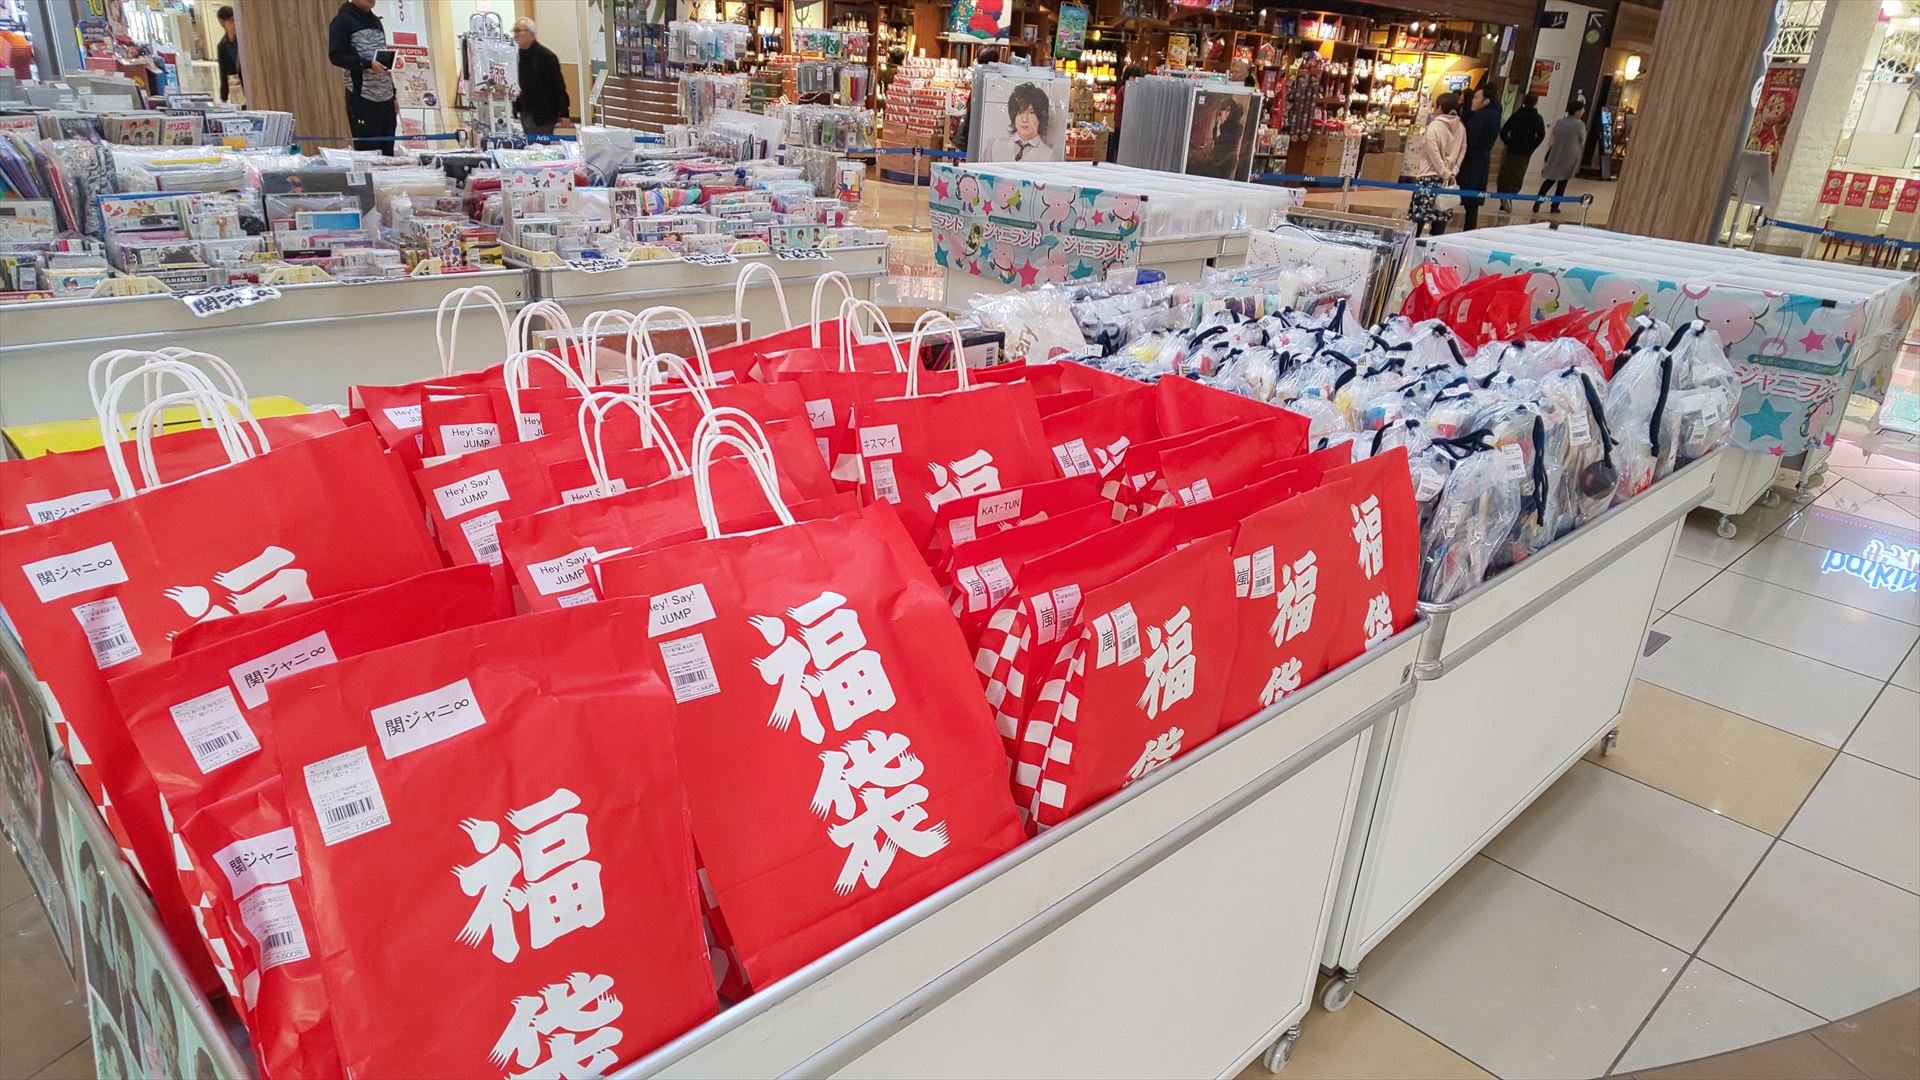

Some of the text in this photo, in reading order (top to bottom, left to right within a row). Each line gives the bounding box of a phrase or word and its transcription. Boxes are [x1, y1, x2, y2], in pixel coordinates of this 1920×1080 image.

[983, 224, 1041, 250] ジャニランド
[1063, 236, 1126, 260] ジャニランド
[809, 410, 826, 422] マイ
[452, 427, 496, 437] Hey! Say!
[463, 439, 490, 449] JUMP
[864, 436, 897, 450] キスマイ
[445, 475, 492, 499] Hey! Say!
[459, 490, 488, 507] JUMP
[981, 499, 1020, 516] KAT-TUN
[37, 558, 113, 586] 関ジャニ∞
[540, 552, 588, 576] Hey! Say!
[555, 569, 586, 585] JUMP
[966, 578, 987, 597] 嵐
[1236, 568, 1249, 587] 嵐
[672, 590, 695, 606] Say!
[660, 607, 691, 626] JUMP
[1040, 606, 1055, 629] 嵐
[1102, 629, 1115, 653] 嵐
[243, 645, 326, 689] 関ジャニ∞
[384, 697, 470, 738] 関ジャニ∞
[748, 591, 951, 897] 福袋
[229, 845, 298, 878] 関ジャニ
